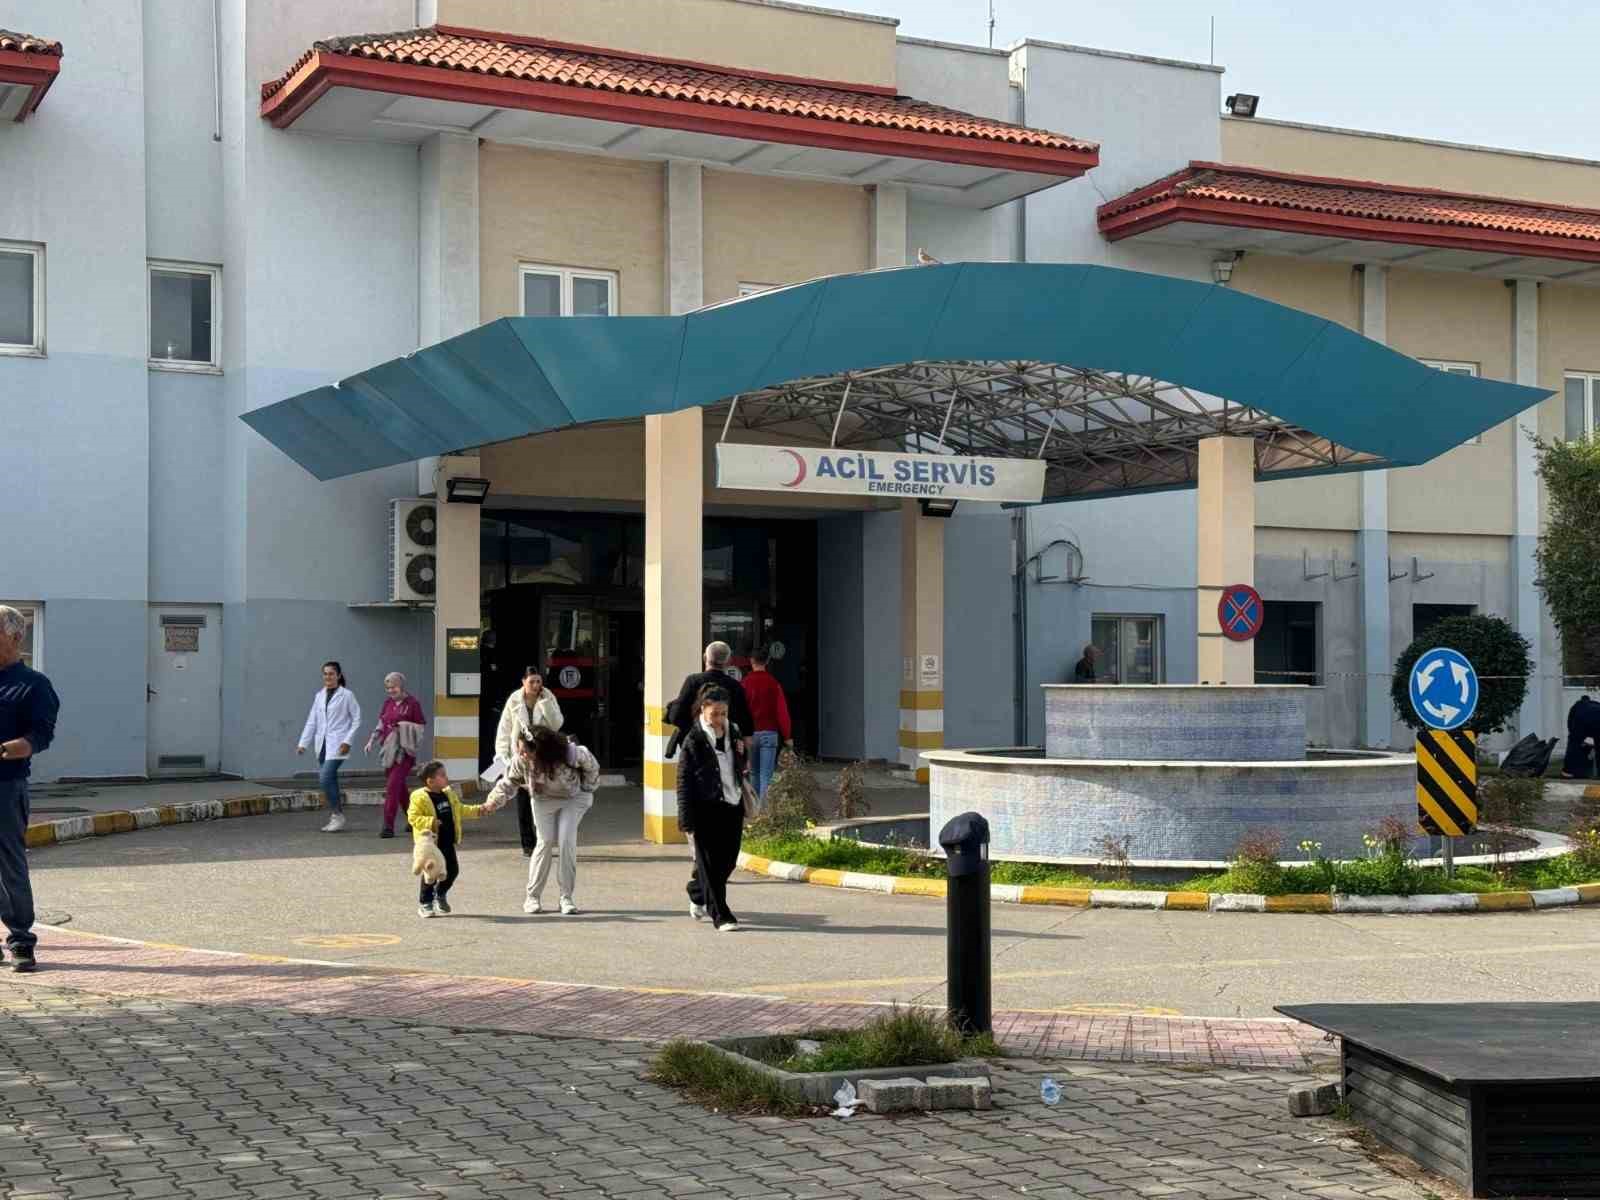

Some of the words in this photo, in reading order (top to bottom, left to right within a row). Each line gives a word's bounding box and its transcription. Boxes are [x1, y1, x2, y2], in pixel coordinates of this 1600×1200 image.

[816, 453, 884, 480] ACİL
[894, 459, 996, 486] SERVİS
[868, 481, 945, 495] EMERGENCY
